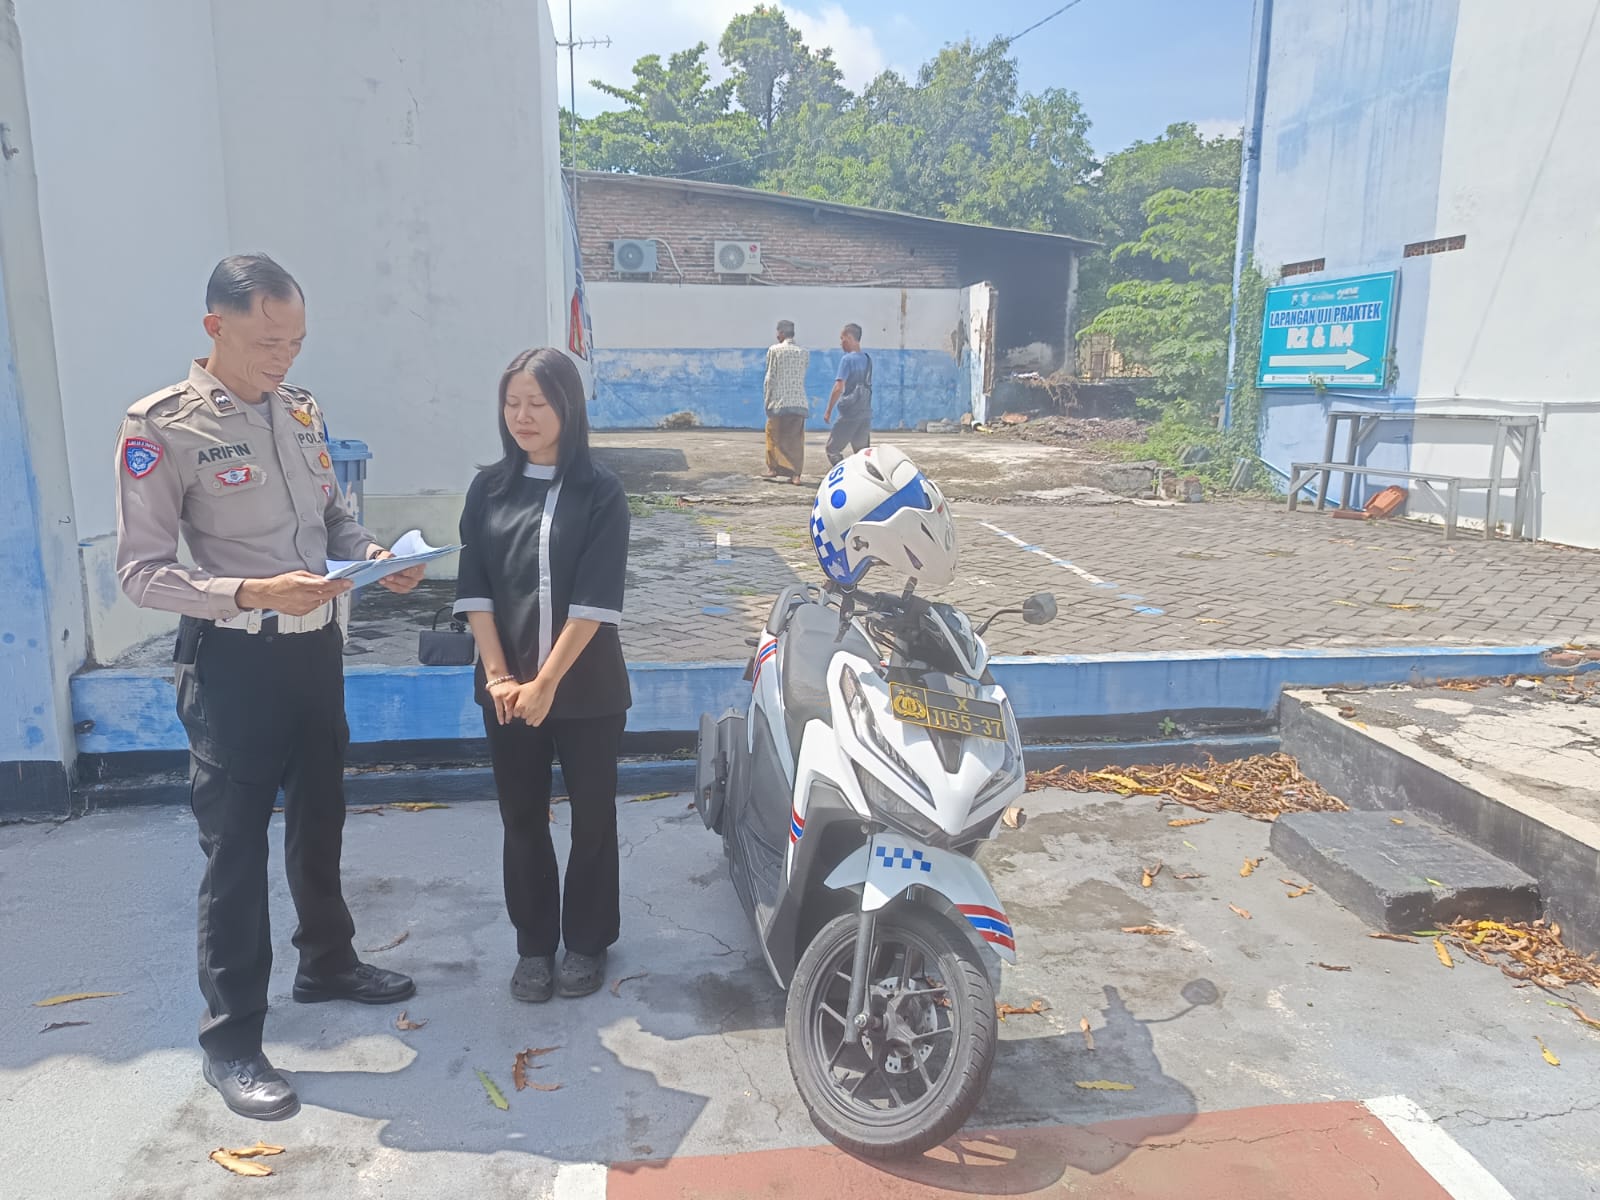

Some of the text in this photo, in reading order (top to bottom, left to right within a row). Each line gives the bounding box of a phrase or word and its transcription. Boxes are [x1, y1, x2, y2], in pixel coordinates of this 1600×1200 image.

[1270, 303, 1381, 327] LAPANGAN UJI PRAKTEK
[198, 442, 252, 465] ARIFIN
[955, 698, 969, 711] X
[932, 709, 1001, 737] 1155-37
